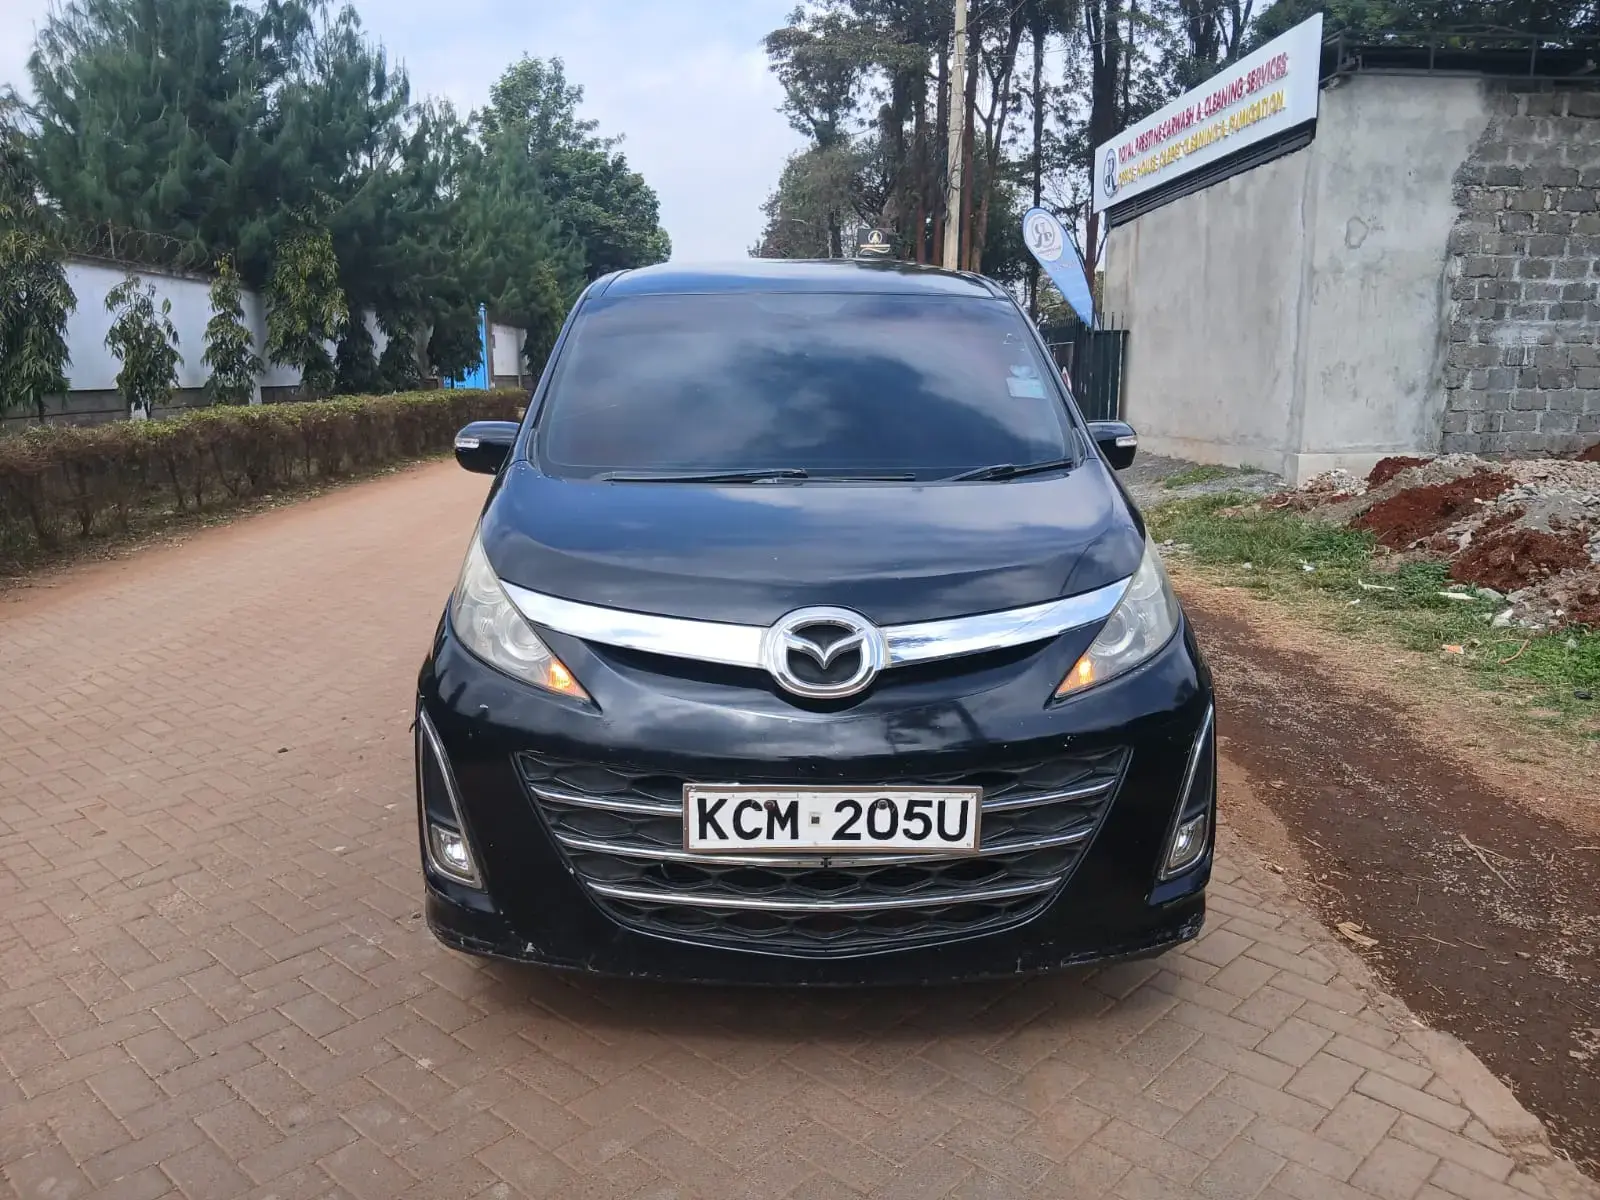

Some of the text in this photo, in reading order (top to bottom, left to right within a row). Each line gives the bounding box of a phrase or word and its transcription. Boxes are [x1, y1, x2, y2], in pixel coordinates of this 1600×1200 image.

[1163, 105, 1194, 138] CARWASH
[1196, 102, 1202, 121] &
[1204, 76, 1243, 117] CLEANING
[1246, 52, 1287, 94] SERVICES
[1229, 88, 1284, 131] FUMIGATION
[697, 797, 969, 842] KCM 205U
